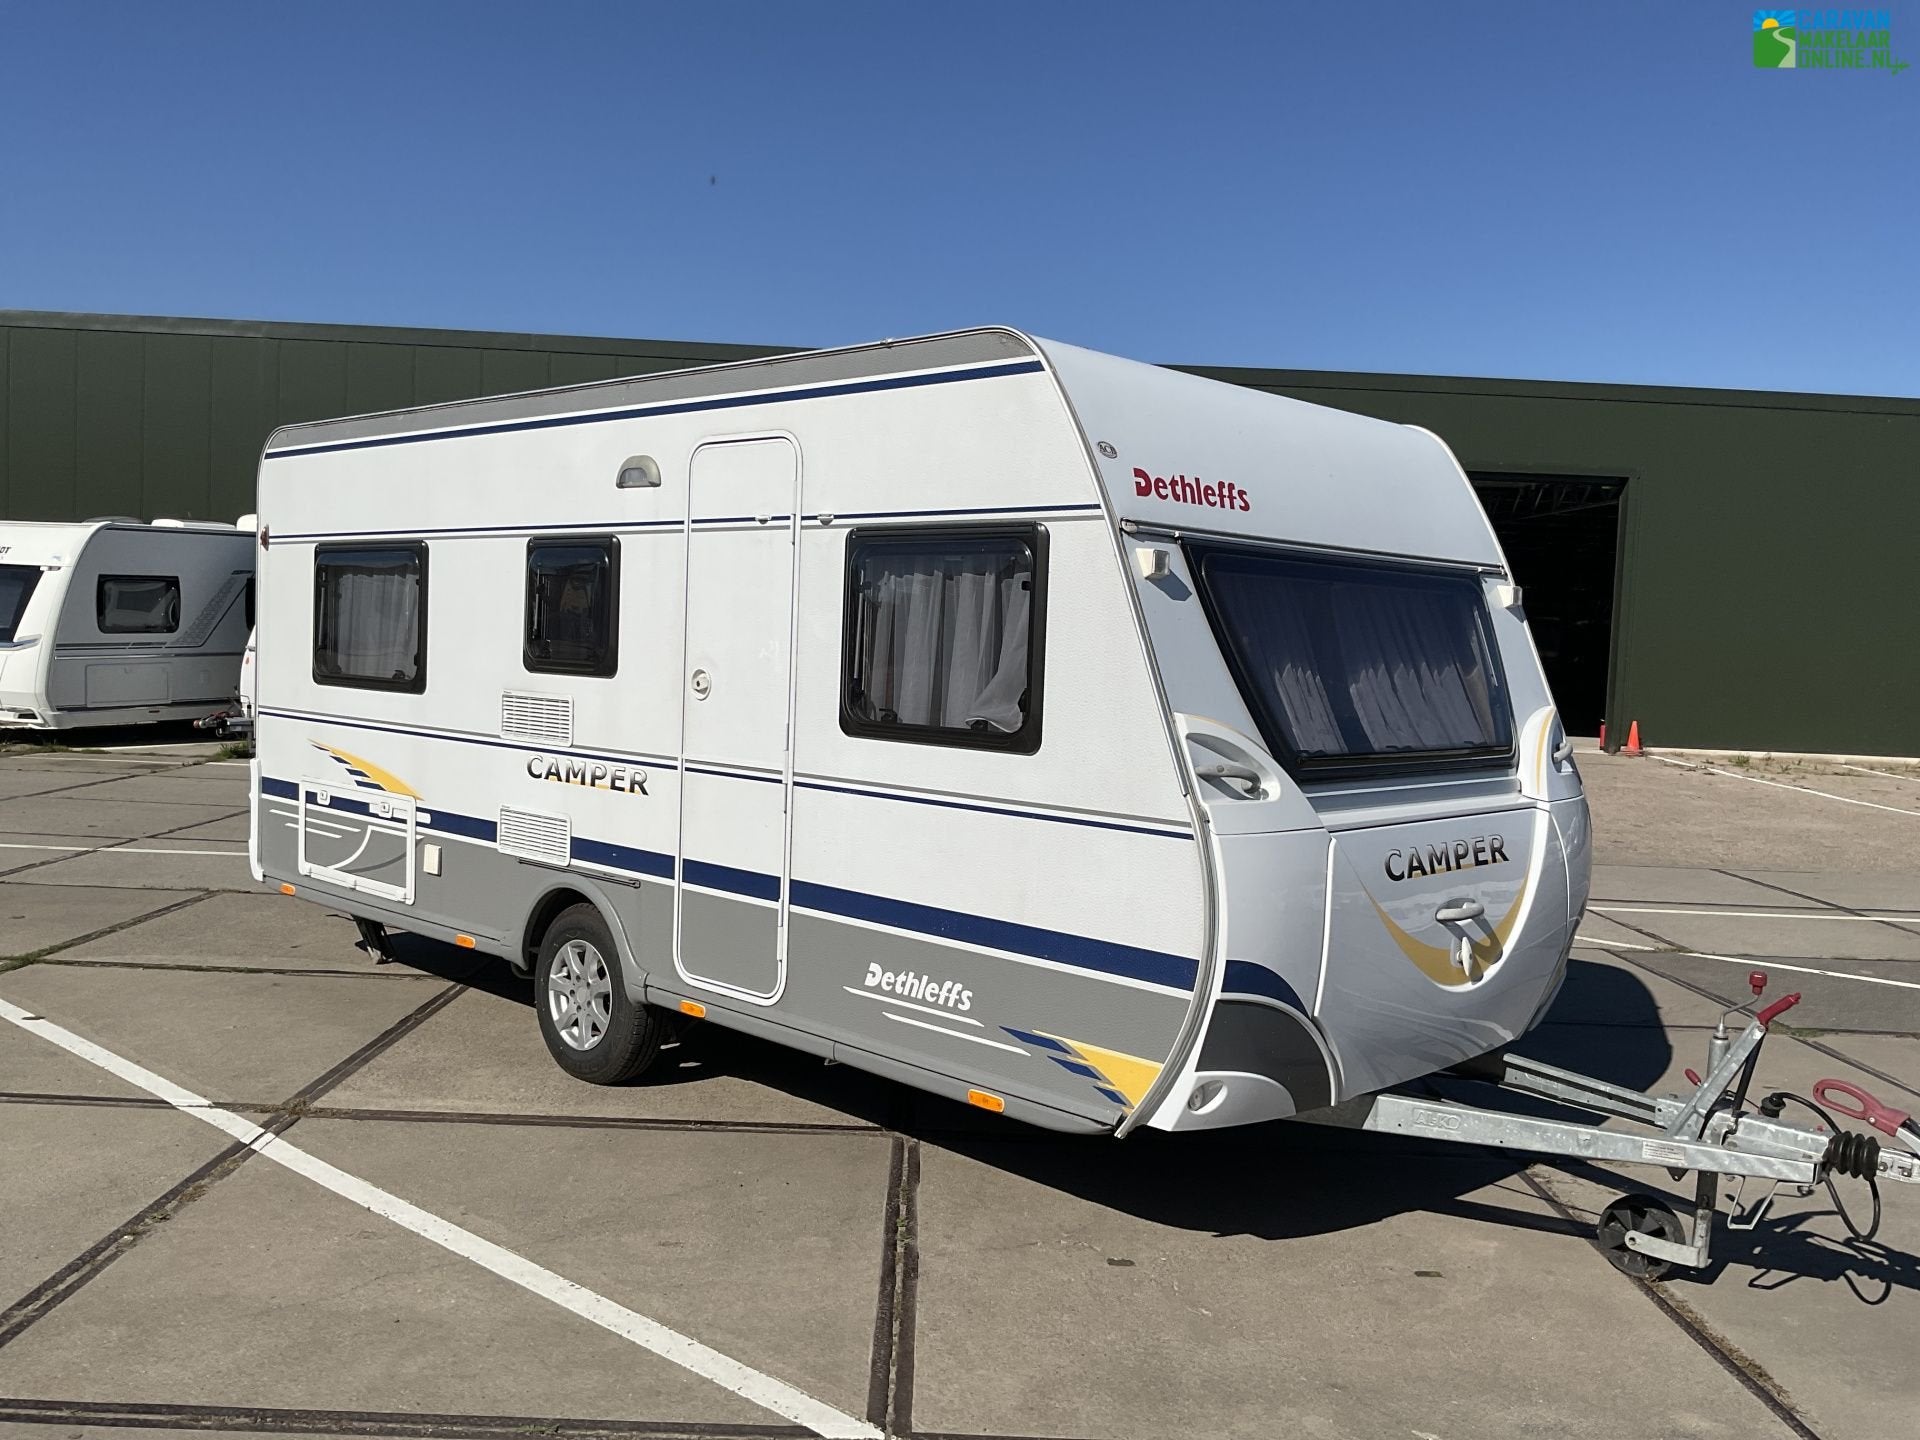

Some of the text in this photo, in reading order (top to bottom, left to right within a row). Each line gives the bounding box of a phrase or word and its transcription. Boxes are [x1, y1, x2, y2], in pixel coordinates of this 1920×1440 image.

[1133, 467, 1250, 512] Dethleffs
[526, 754, 650, 796] CAMPER
[1384, 833, 1510, 882] CAMPER
[864, 962, 973, 1011] Dethleffs
